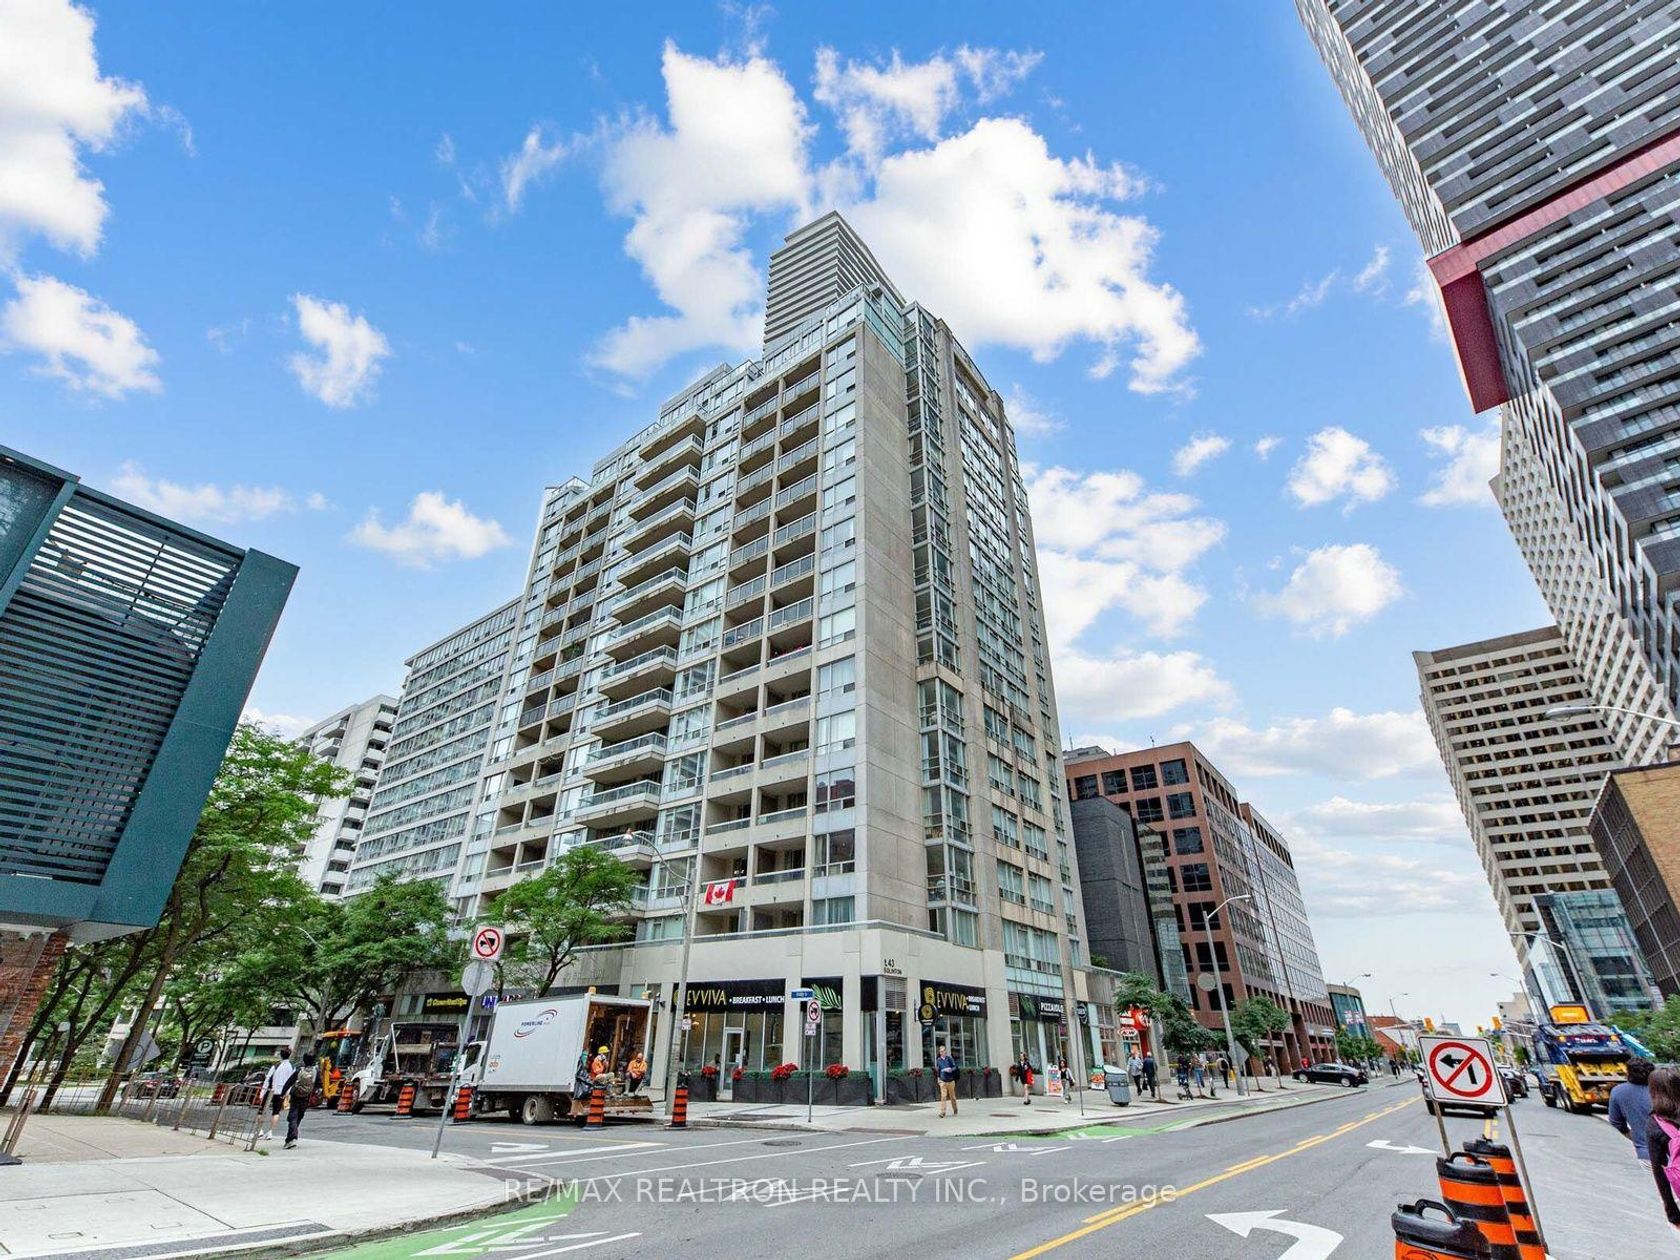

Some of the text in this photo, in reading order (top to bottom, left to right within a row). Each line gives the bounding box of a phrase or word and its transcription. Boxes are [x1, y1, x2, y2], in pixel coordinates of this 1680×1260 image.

[884, 959, 895, 967] 143
[686, 989, 785, 1007] EVVIVA BREAKFAST LUNCH
[936, 991, 968, 1011] EVVIVA
